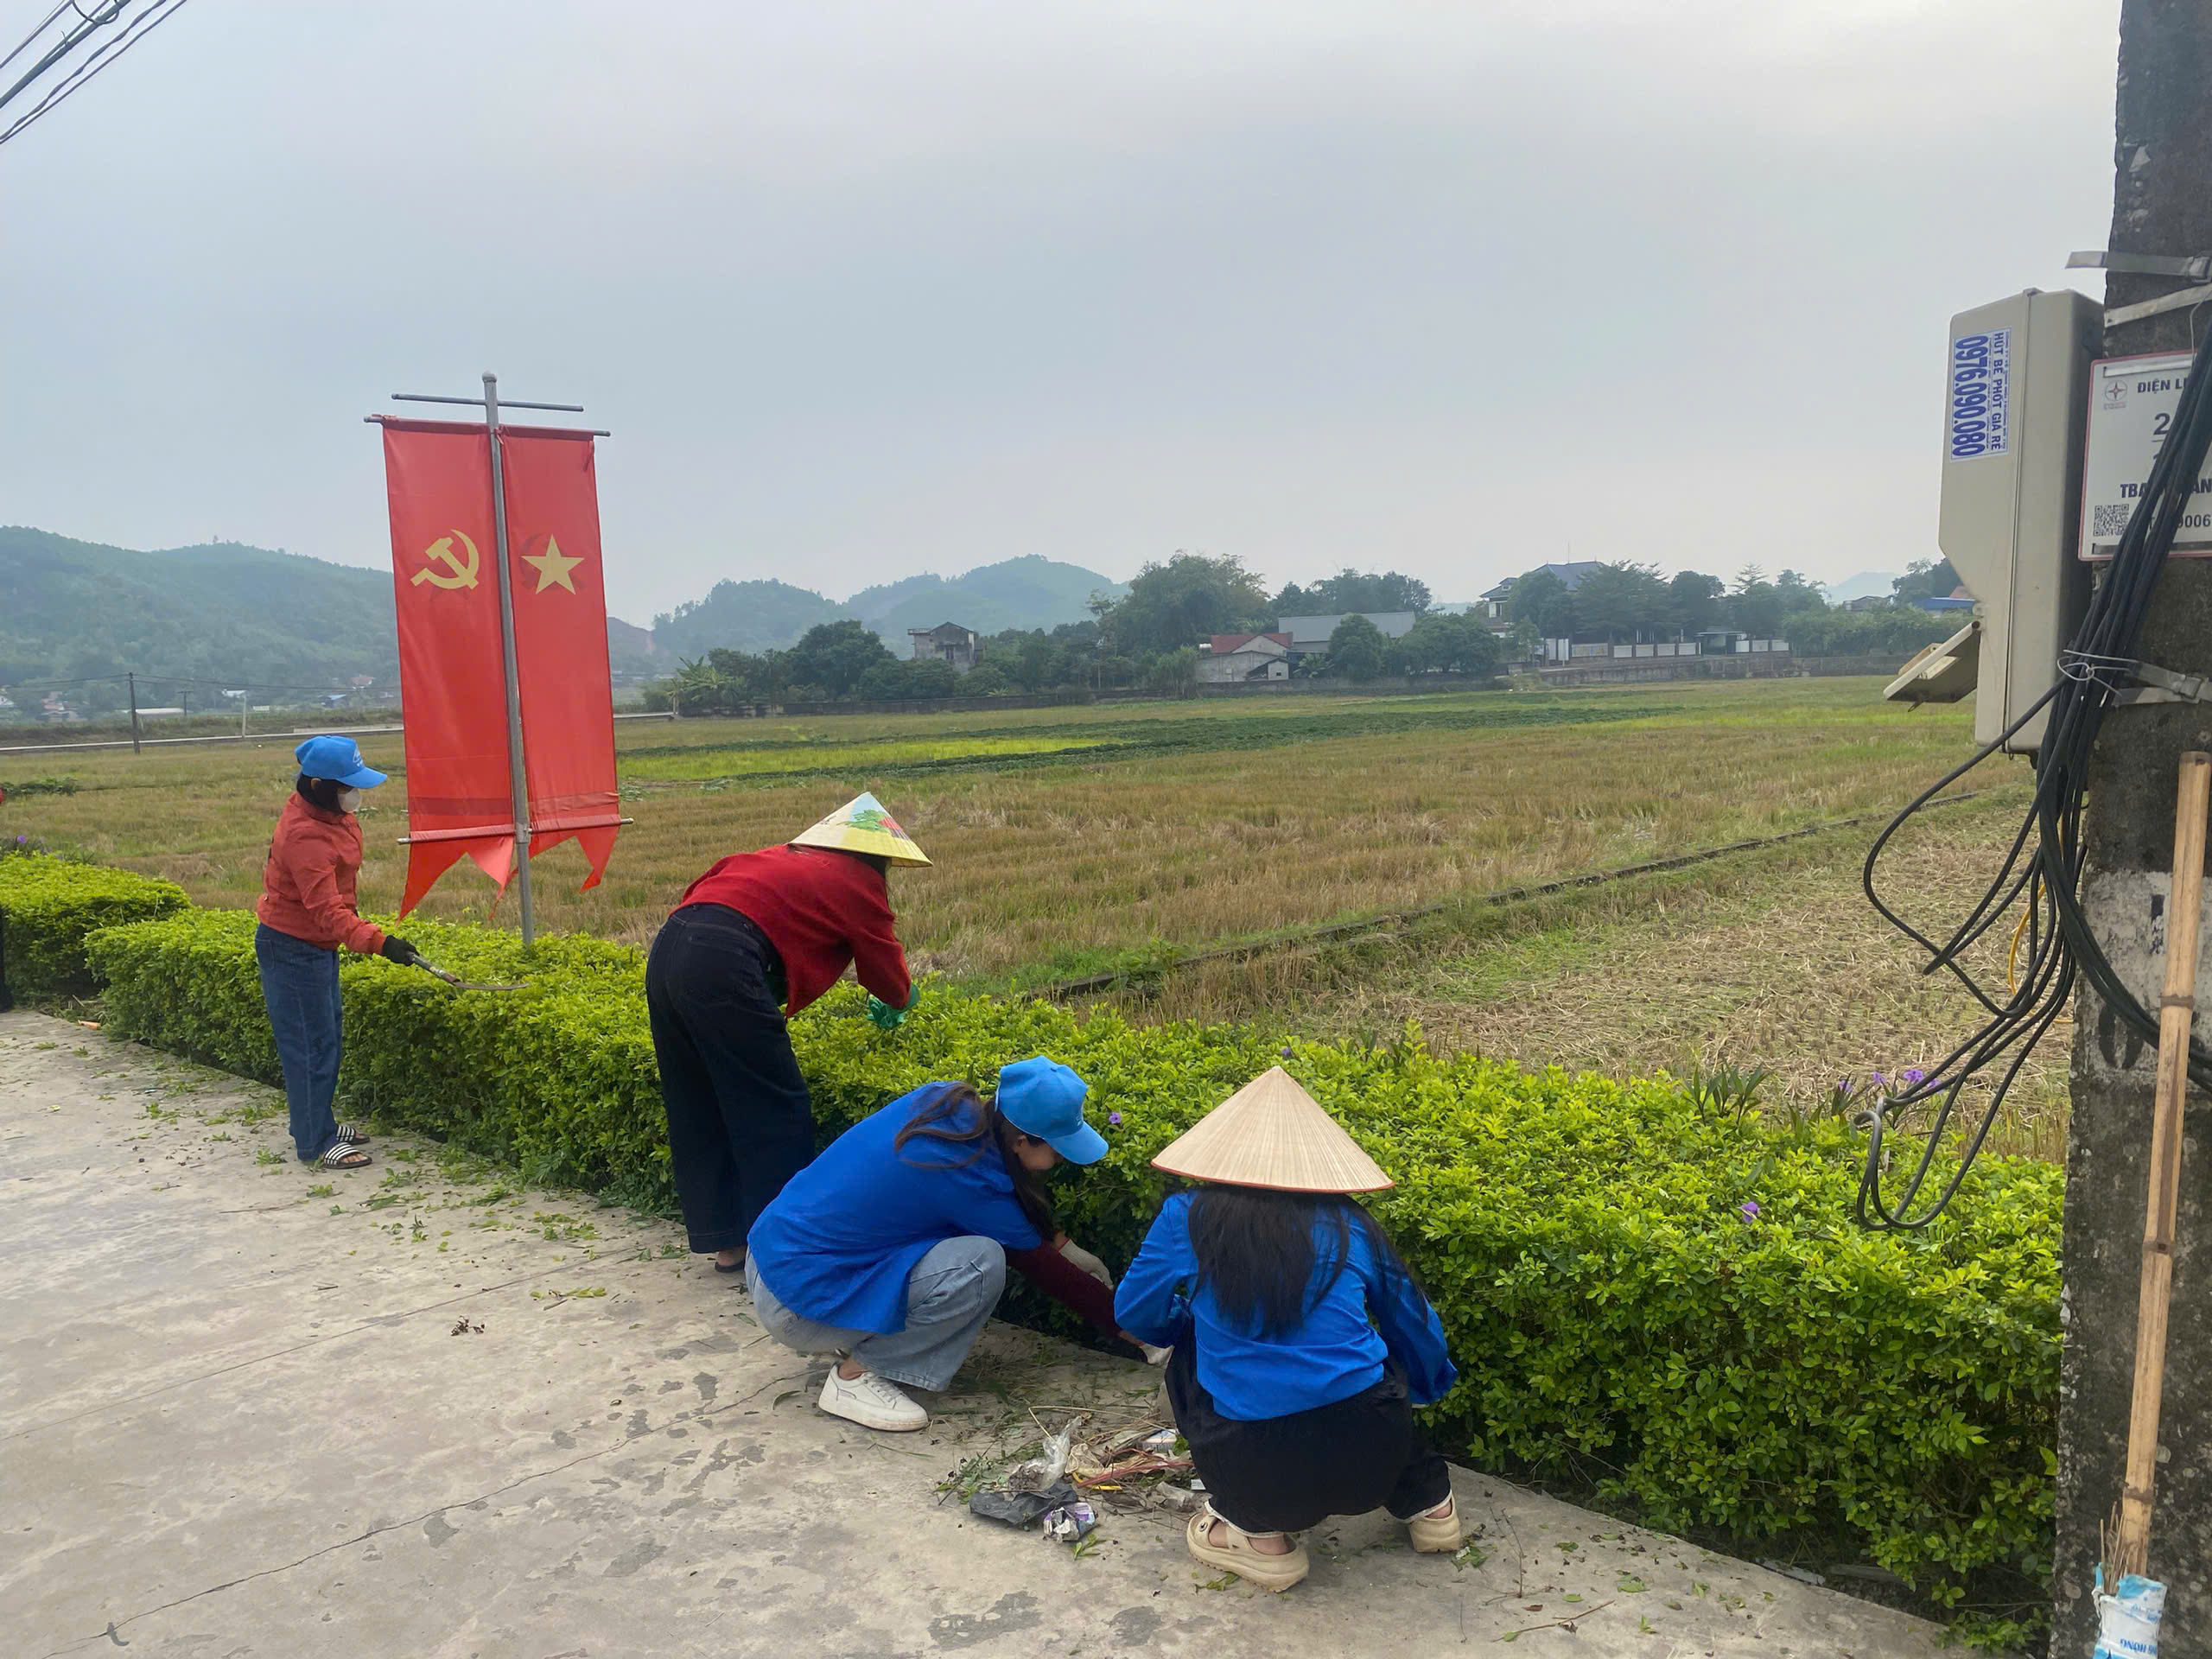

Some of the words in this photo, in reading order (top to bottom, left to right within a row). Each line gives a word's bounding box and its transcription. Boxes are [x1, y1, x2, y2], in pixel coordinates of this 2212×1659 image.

[1994, 332, 2005, 354] HÚT
[1952, 335, 1988, 456] 0976.090.080
[2137, 378, 2171, 394] ĐIỆN
